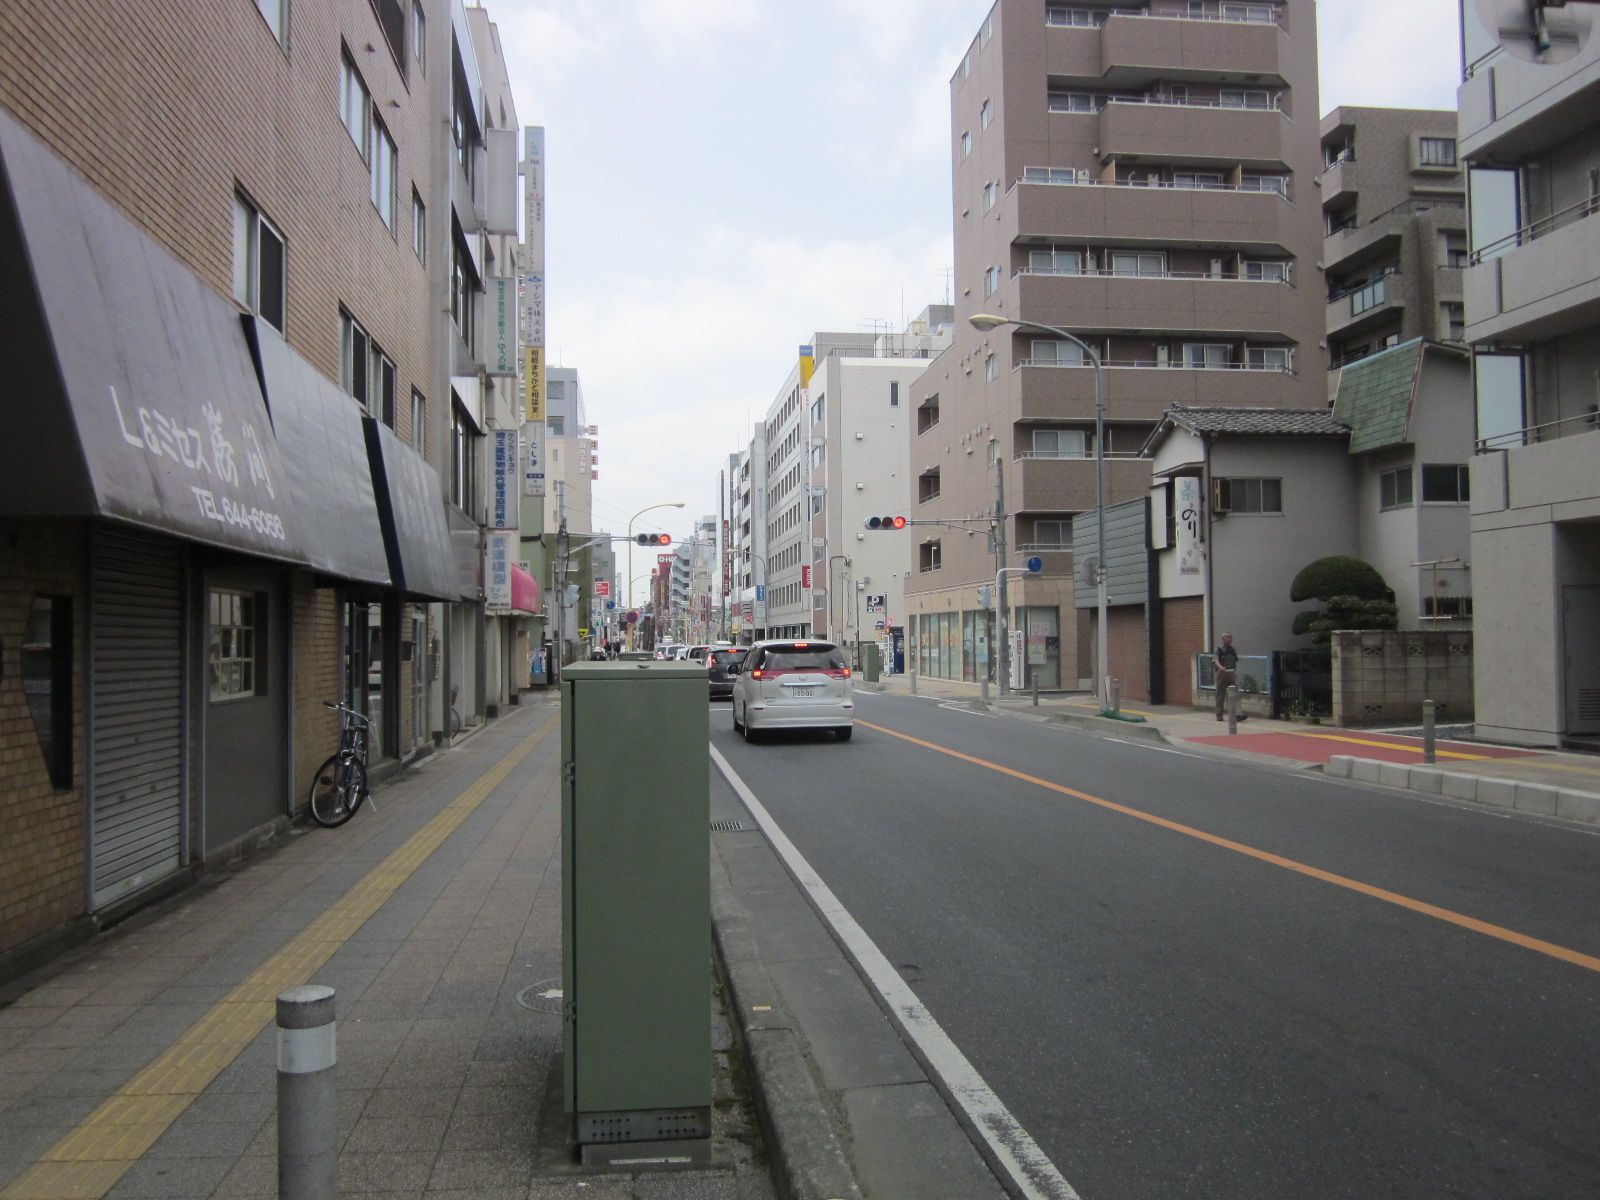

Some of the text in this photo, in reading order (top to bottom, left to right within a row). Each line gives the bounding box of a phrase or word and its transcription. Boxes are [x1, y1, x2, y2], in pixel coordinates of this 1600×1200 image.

[531, 349, 539, 413] 相続まちかど相談室
[191, 486, 286, 541] TEL 644-6058
